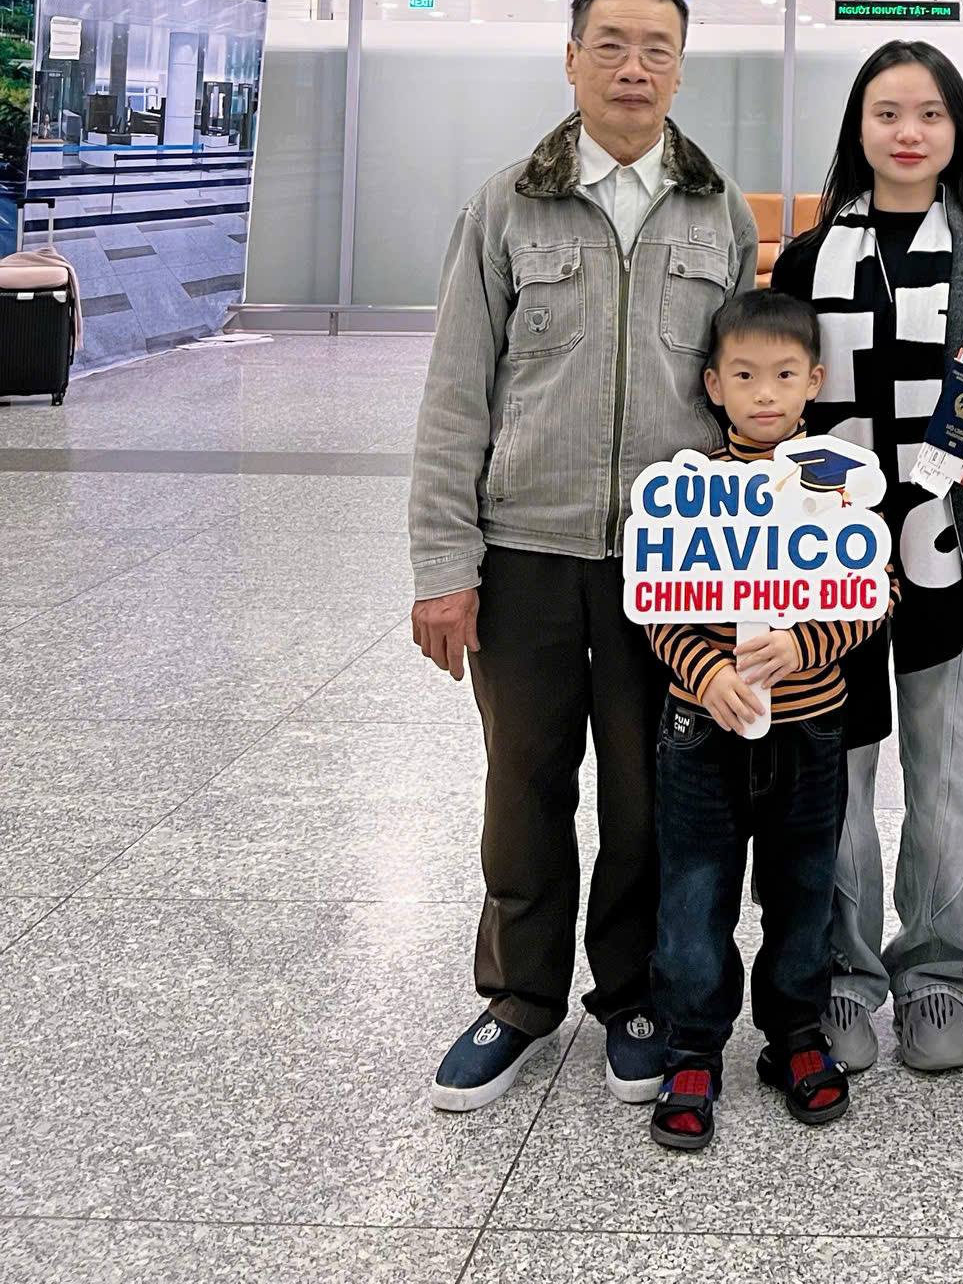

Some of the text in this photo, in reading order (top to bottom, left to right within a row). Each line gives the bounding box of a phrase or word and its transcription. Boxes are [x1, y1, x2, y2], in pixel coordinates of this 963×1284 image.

[643, 462, 774, 518] CÙNG
[635, 524, 878, 573] HAVICO
[635, 572, 878, 618] CHINH PHỤC ĐỨC
[675, 714, 690, 726] PUN
